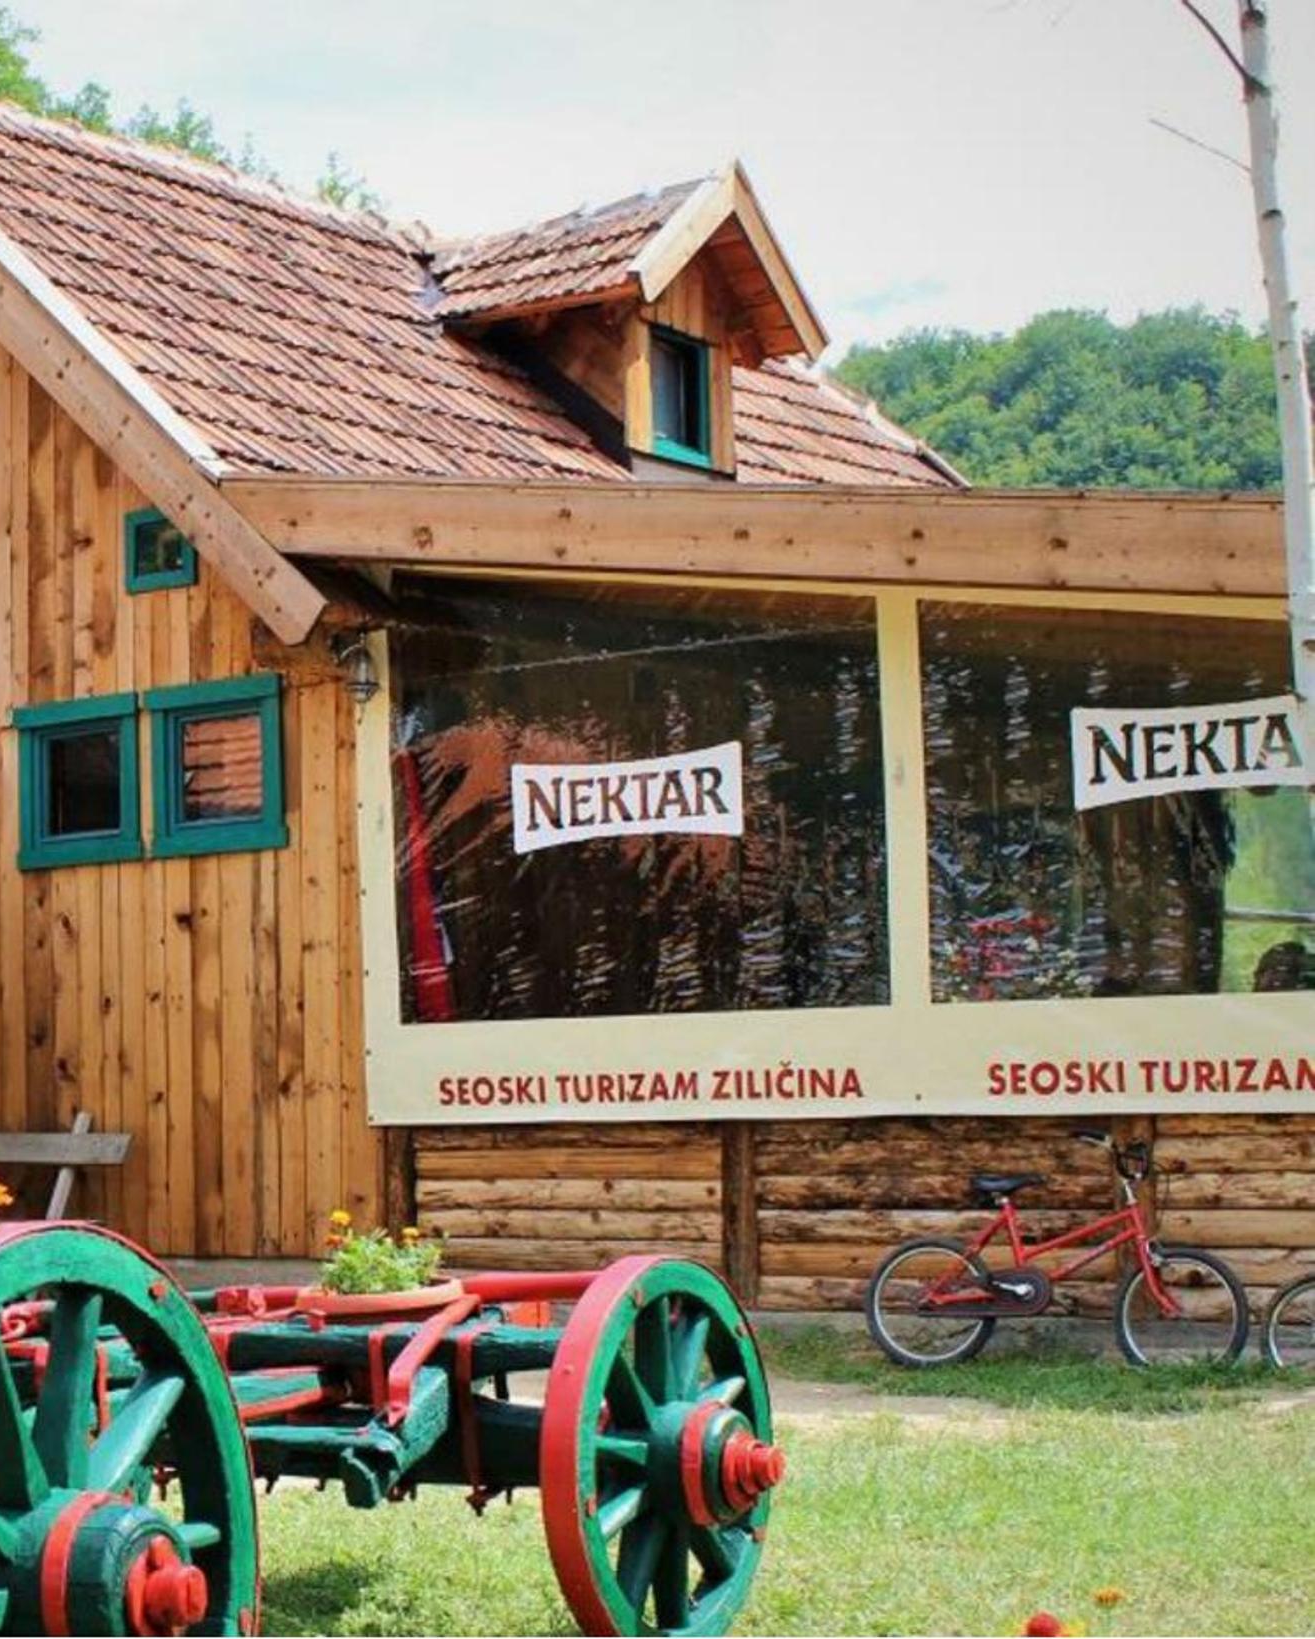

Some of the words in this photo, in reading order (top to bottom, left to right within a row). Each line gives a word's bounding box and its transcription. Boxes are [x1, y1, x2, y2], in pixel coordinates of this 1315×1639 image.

[1086, 712, 1303, 785] NEKTA
[524, 766, 730, 831] NEKTAR
[439, 1074, 546, 1106] SEOSKI
[555, 1072, 699, 1102] TURIZAM
[711, 1060, 864, 1100] ZILIČINA
[988, 1061, 1126, 1095] SEOSKI
